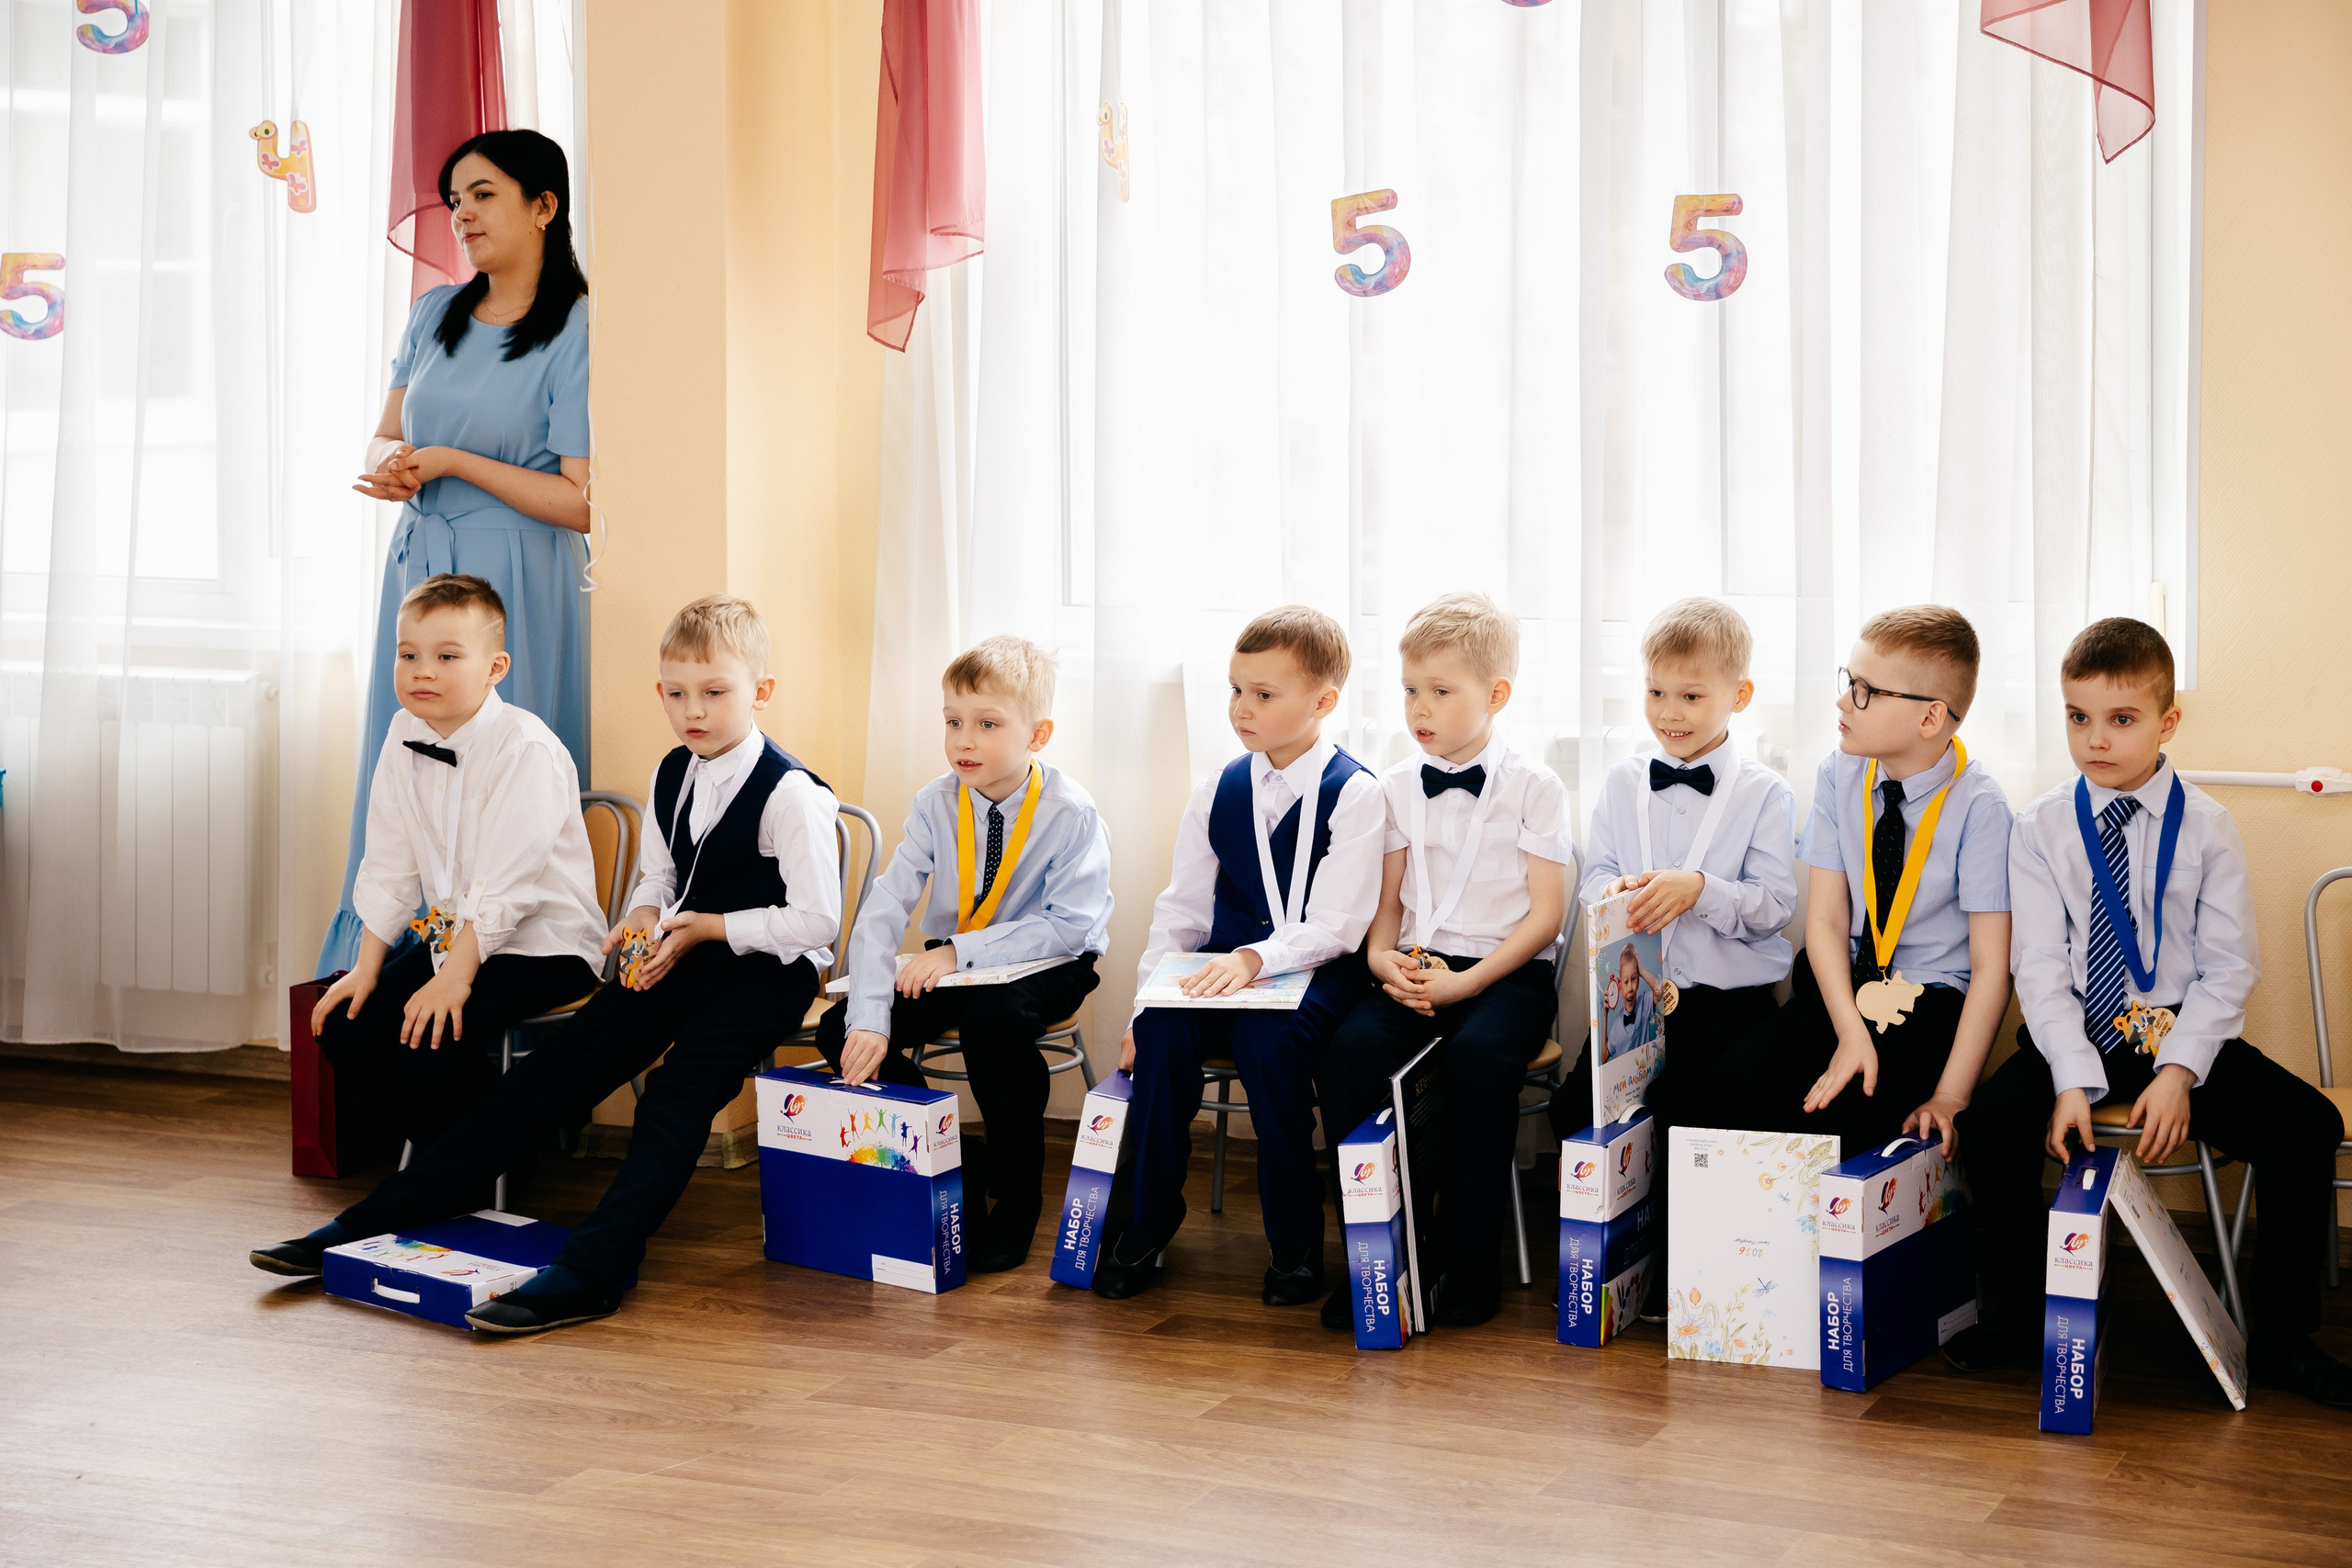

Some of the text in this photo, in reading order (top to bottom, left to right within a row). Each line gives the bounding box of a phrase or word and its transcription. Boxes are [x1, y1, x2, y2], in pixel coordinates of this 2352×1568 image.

[77, 0, 149, 54] 5
[249, 119, 317, 213] 4
[1331, 188, 1411, 297] 5
[1664, 193, 1747, 301] 5
[0, 253, 65, 340] 5
[939, 1190, 951, 1274] ДЛЯ ТВОРЧЕСТВА
[950, 1202, 961, 1255] НАБОР
[1064, 1197, 1084, 1250] НАБОР
[1075, 1186, 1101, 1271] ДЛЯ ТВОРЧЕСТВА
[1738, 1247, 1763, 1258] 2026
[1357, 1241, 1375, 1333] ДЛЯ ТВОРЧЕСТВА
[1373, 1259, 1390, 1315] НАБОР
[1568, 1236, 1579, 1327] ДЛЯ ТВОРЧЕСТВА
[1581, 1258, 1593, 1314] НАБОР
[1827, 1292, 1839, 1350] НАБОР
[1842, 1277, 1853, 1372] ДЛЯ ТВОРЧЕСТВА
[2054, 1315, 2068, 1414] ДЛЯ ТВОРЧЕСТВА
[2070, 1337, 2086, 1399] НАБОР
